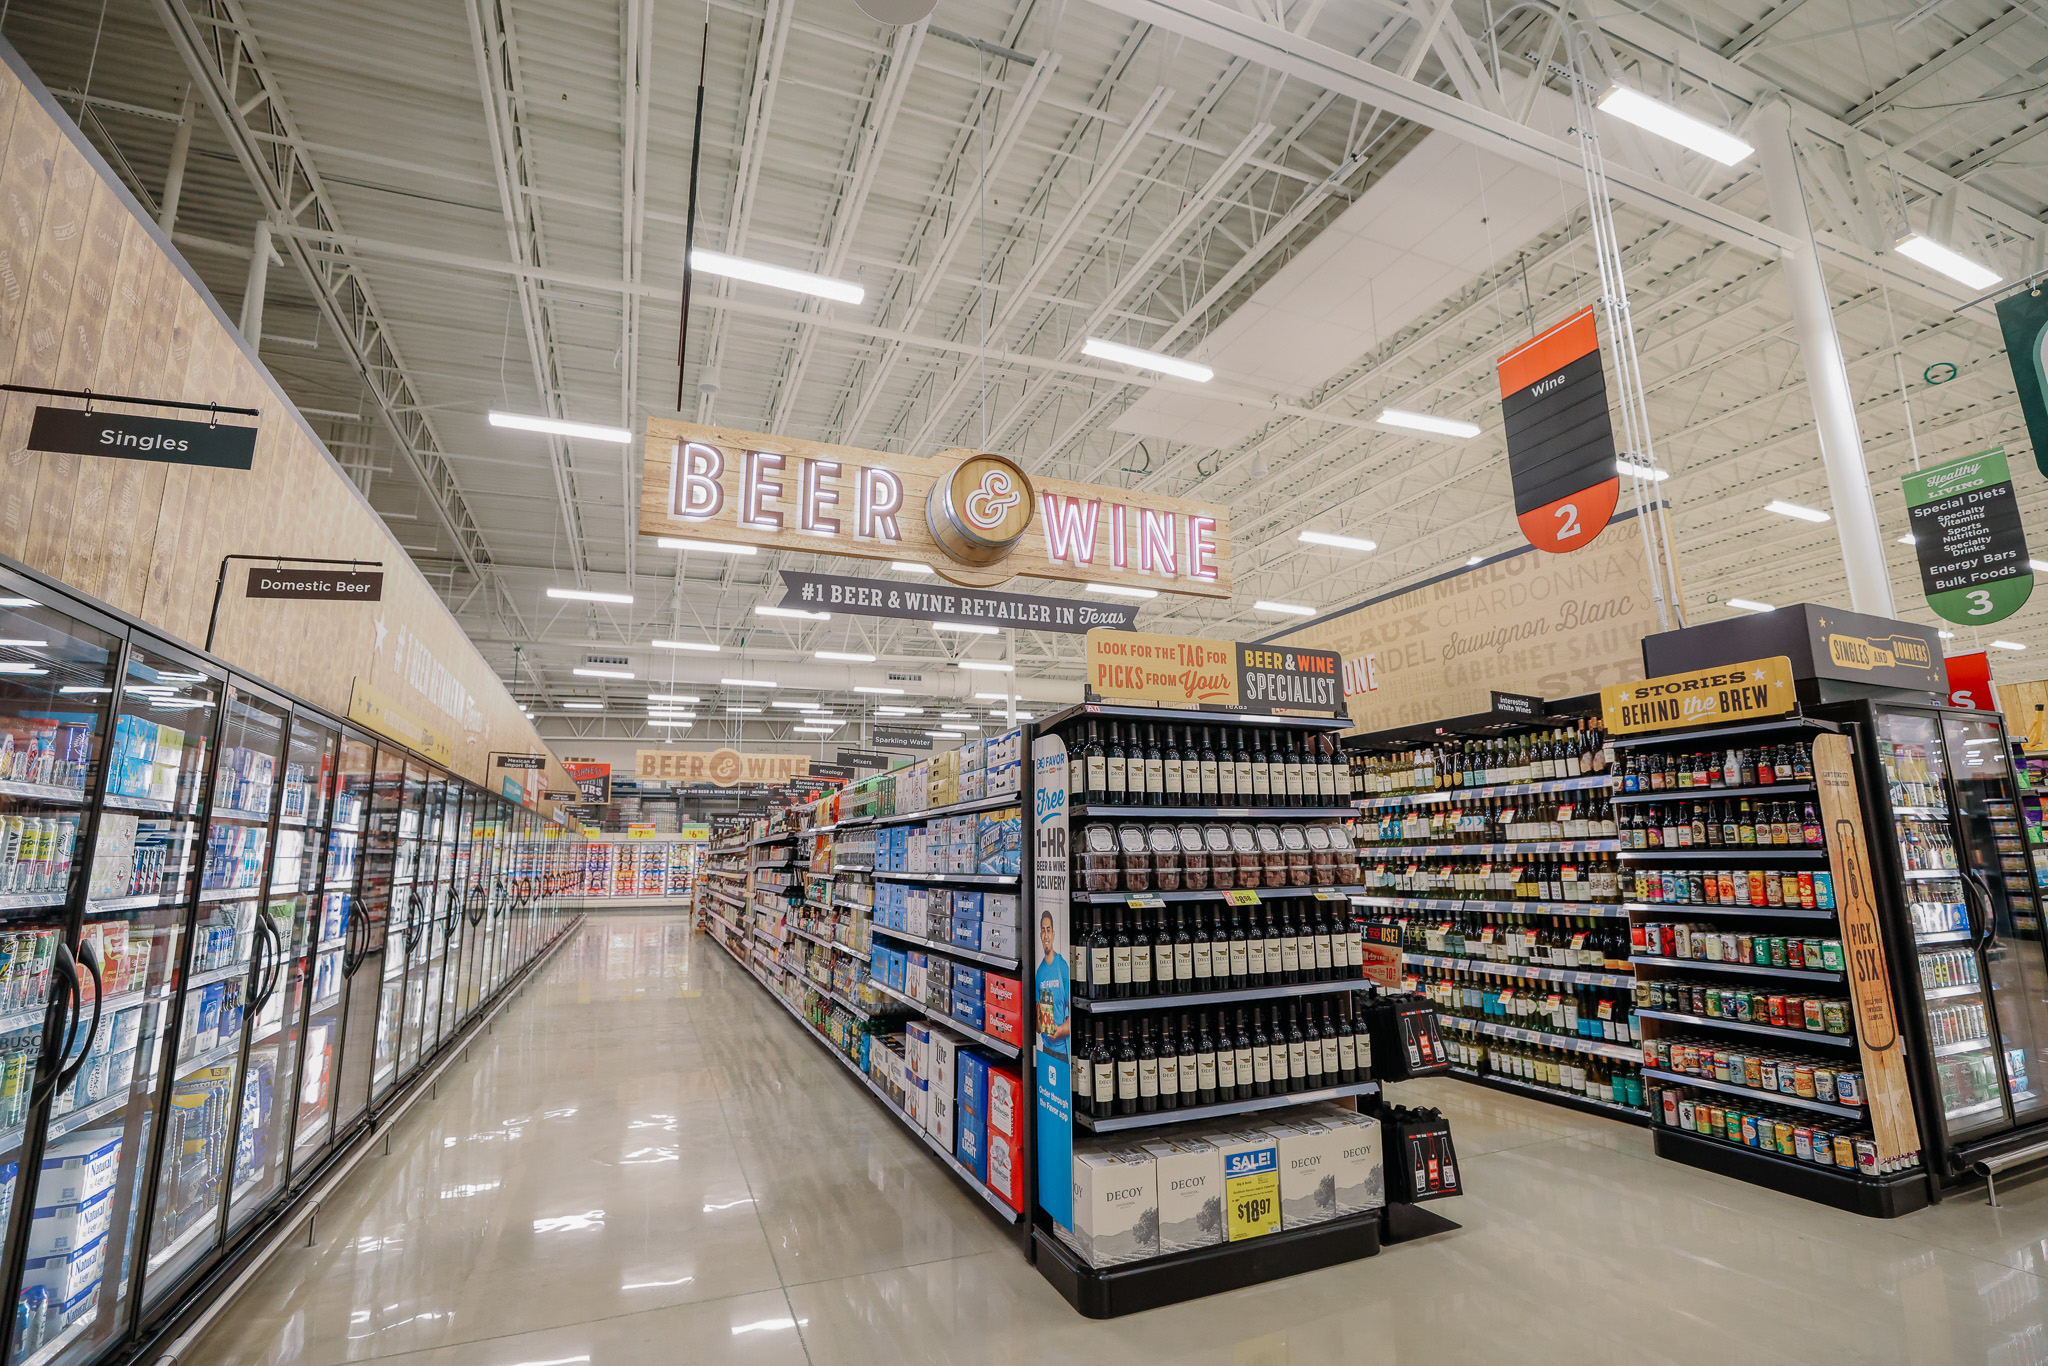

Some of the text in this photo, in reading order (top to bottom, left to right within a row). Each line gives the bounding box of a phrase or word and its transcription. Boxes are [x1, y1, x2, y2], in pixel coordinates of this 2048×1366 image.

[42, 270, 67, 296] BREW
[77, 325, 93, 362] BREW
[1531, 372, 1566, 397] Wine
[100, 429, 189, 452] Singles
[1927, 463, 1981, 488] Healthy
[1928, 478, 1985, 499] LIVING
[670, 440, 1219, 581] BEER & WINE
[1914, 487, 2006, 518] Special Diets
[1937, 505, 1985, 523] Specialty
[1553, 504, 1582, 541] 2
[1940, 512, 1986, 528] Vitamins
[1947, 522, 1982, 536] Sports
[1943, 527, 1990, 543] Nutrition
[1943, 535, 1992, 552] Specialty
[1952, 544, 1986, 557] Drinks
[1930, 549, 2017, 576] Energy Bars
[260, 578, 371, 594] Domestic Beer
[1391, 589, 1428, 615] SYRAH
[1433, 553, 1541, 601] MERLOT
[1436, 546, 1647, 628] CHARDONNAY
[1936, 566, 2017, 589] Bulk Foods
[802, 583, 1127, 627] #1 BEER & WINE RETAILER IN Texas
[1965, 590, 1994, 616] 3
[1443, 616, 1549, 666] Sauvignon
[1555, 595, 1635, 631] Blanc
[1097, 642, 1228, 668] LOOK FOR THE TAG FOR
[1245, 650, 1335, 674] BEER & WINE
[1834, 639, 1928, 665] SINGLES AND BOMBERS
[1443, 640, 1558, 688] CABERNET
[1098, 664, 1231, 699] PICKS FROM Your
[1246, 672, 1335, 705] SPECIALIST
[1635, 671, 1747, 699] STORIES
[1498, 703, 1532, 715] White Wines
[1500, 695, 1530, 707] Interesting
[1622, 685, 1768, 727] BEHIND the BREW
[875, 736, 930, 747] Sparkling Water
[642, 755, 807, 778] BEER & WINE
[853, 758, 872, 766] Mixers
[1045, 753, 1065, 767] FAVOR
[820, 768, 844, 777] Mixology
[1036, 787, 1066, 817] Free
[1036, 828, 1066, 858] 1-HR
[1036, 860, 1048, 872] BEER
[1053, 860, 1066, 872] WINE
[1036, 874, 1066, 891] DELIVERY
[1381, 928, 1398, 943] USE!
[1851, 922, 1874, 947] PICK
[1856, 948, 1880, 983] SIX
[989, 1014, 1013, 1032] Budweiser
[0, 1035, 42, 1049] BUSC
[934, 1040, 947, 1064] Lite
[963, 1084, 975, 1098] LIGHT
[964, 1075, 974, 1088] BUD
[934, 1095, 946, 1117] Lite
[1038, 1085, 1069, 1109] Order through
[1046, 1101, 1058, 1114] Favor
[1058, 1107, 1068, 1122] app
[963, 1128, 975, 1143] BUD
[961, 1138, 977, 1159] LIGHT
[1343, 1145, 1371, 1159] DECOY
[91, 1155, 112, 1178] Natural
[1232, 1152, 1271, 1171] SALE!
[1291, 1156, 1322, 1169] DECOY
[1106, 1187, 1143, 1202] DECOY
[1171, 1176, 1206, 1191] DECOY
[84, 1204, 105, 1226] Natural
[75, 1251, 97, 1278] Natural
